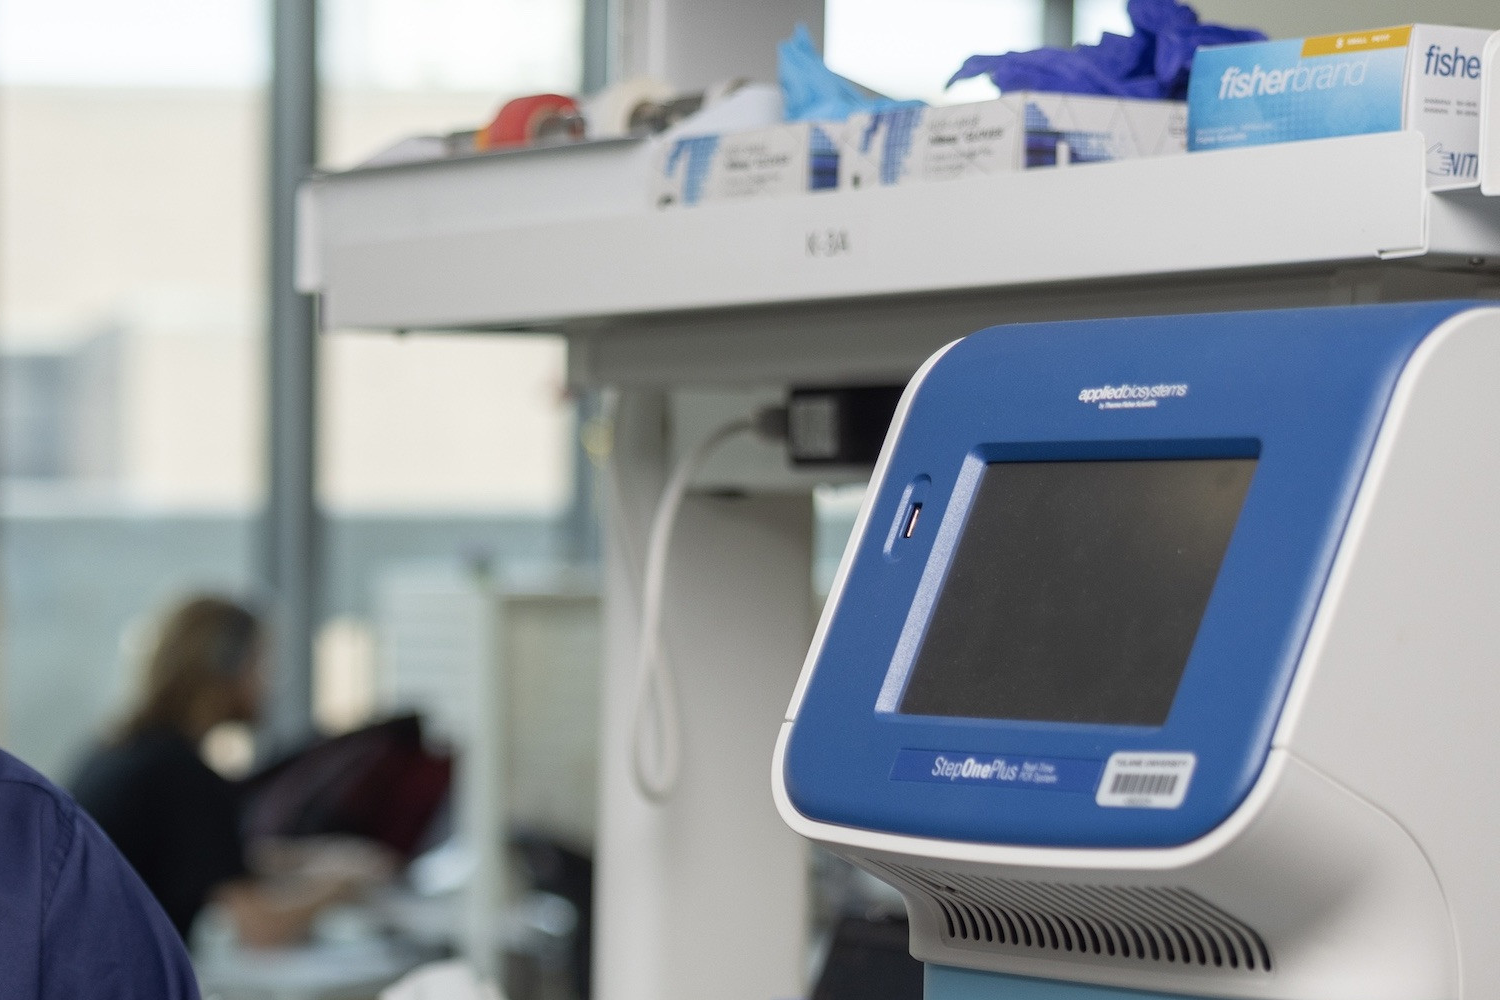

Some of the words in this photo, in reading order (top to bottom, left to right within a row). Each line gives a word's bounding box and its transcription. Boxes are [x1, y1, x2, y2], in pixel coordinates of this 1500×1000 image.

[1219, 53, 1368, 100] fisherbrand
[1078, 384, 1187, 402] appliedbiosystems
[931, 756, 1018, 781] StepOnePlus
